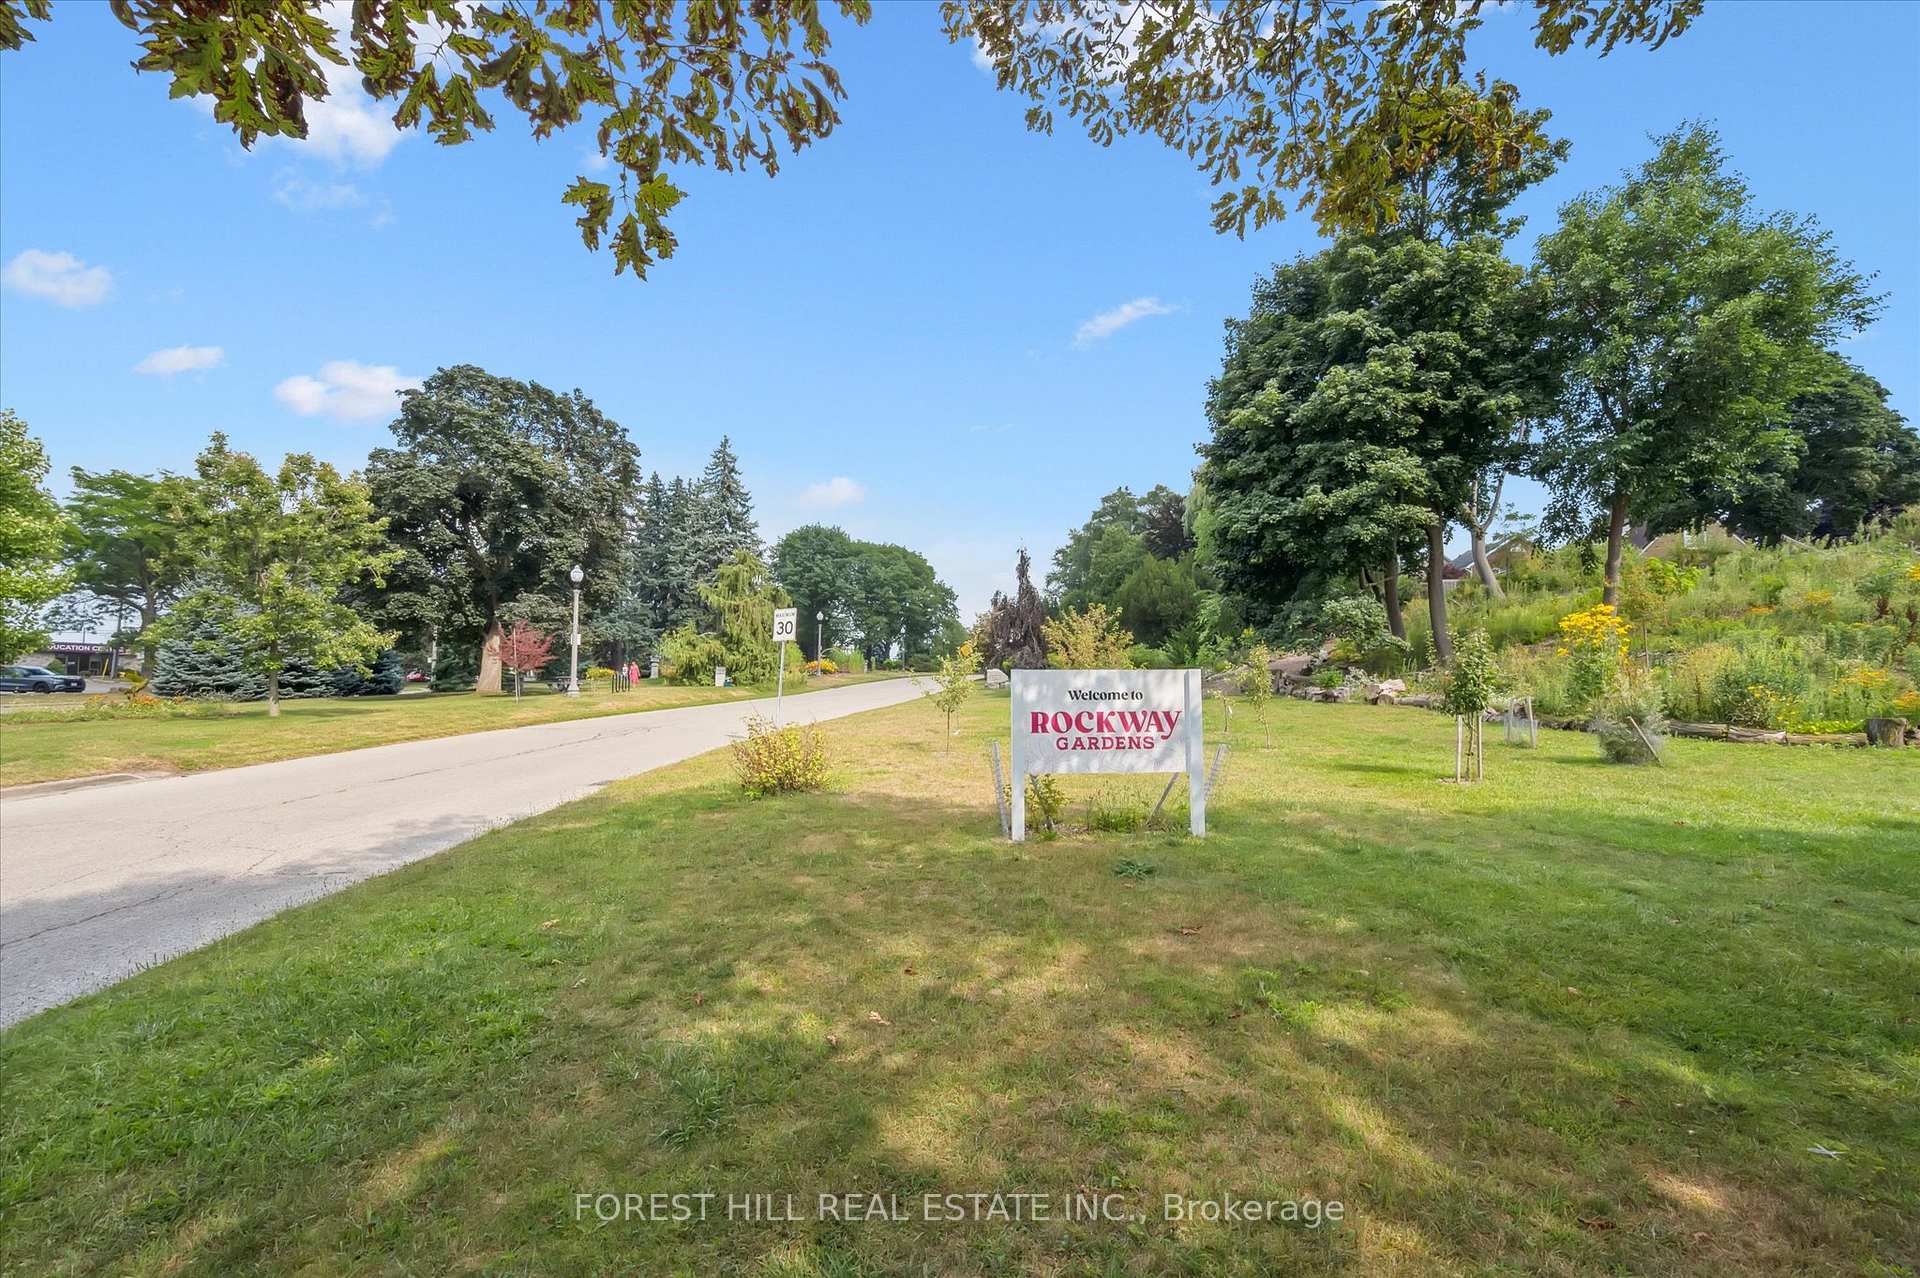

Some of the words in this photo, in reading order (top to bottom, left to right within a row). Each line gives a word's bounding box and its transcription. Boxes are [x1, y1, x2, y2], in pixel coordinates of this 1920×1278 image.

[776, 621, 793, 635] 30
[1068, 690, 1128, 701] Welcome
[1131, 690, 1143, 701] to
[1030, 710, 1182, 740] ROCKWAY
[1056, 736, 1155, 750] GARDENS
